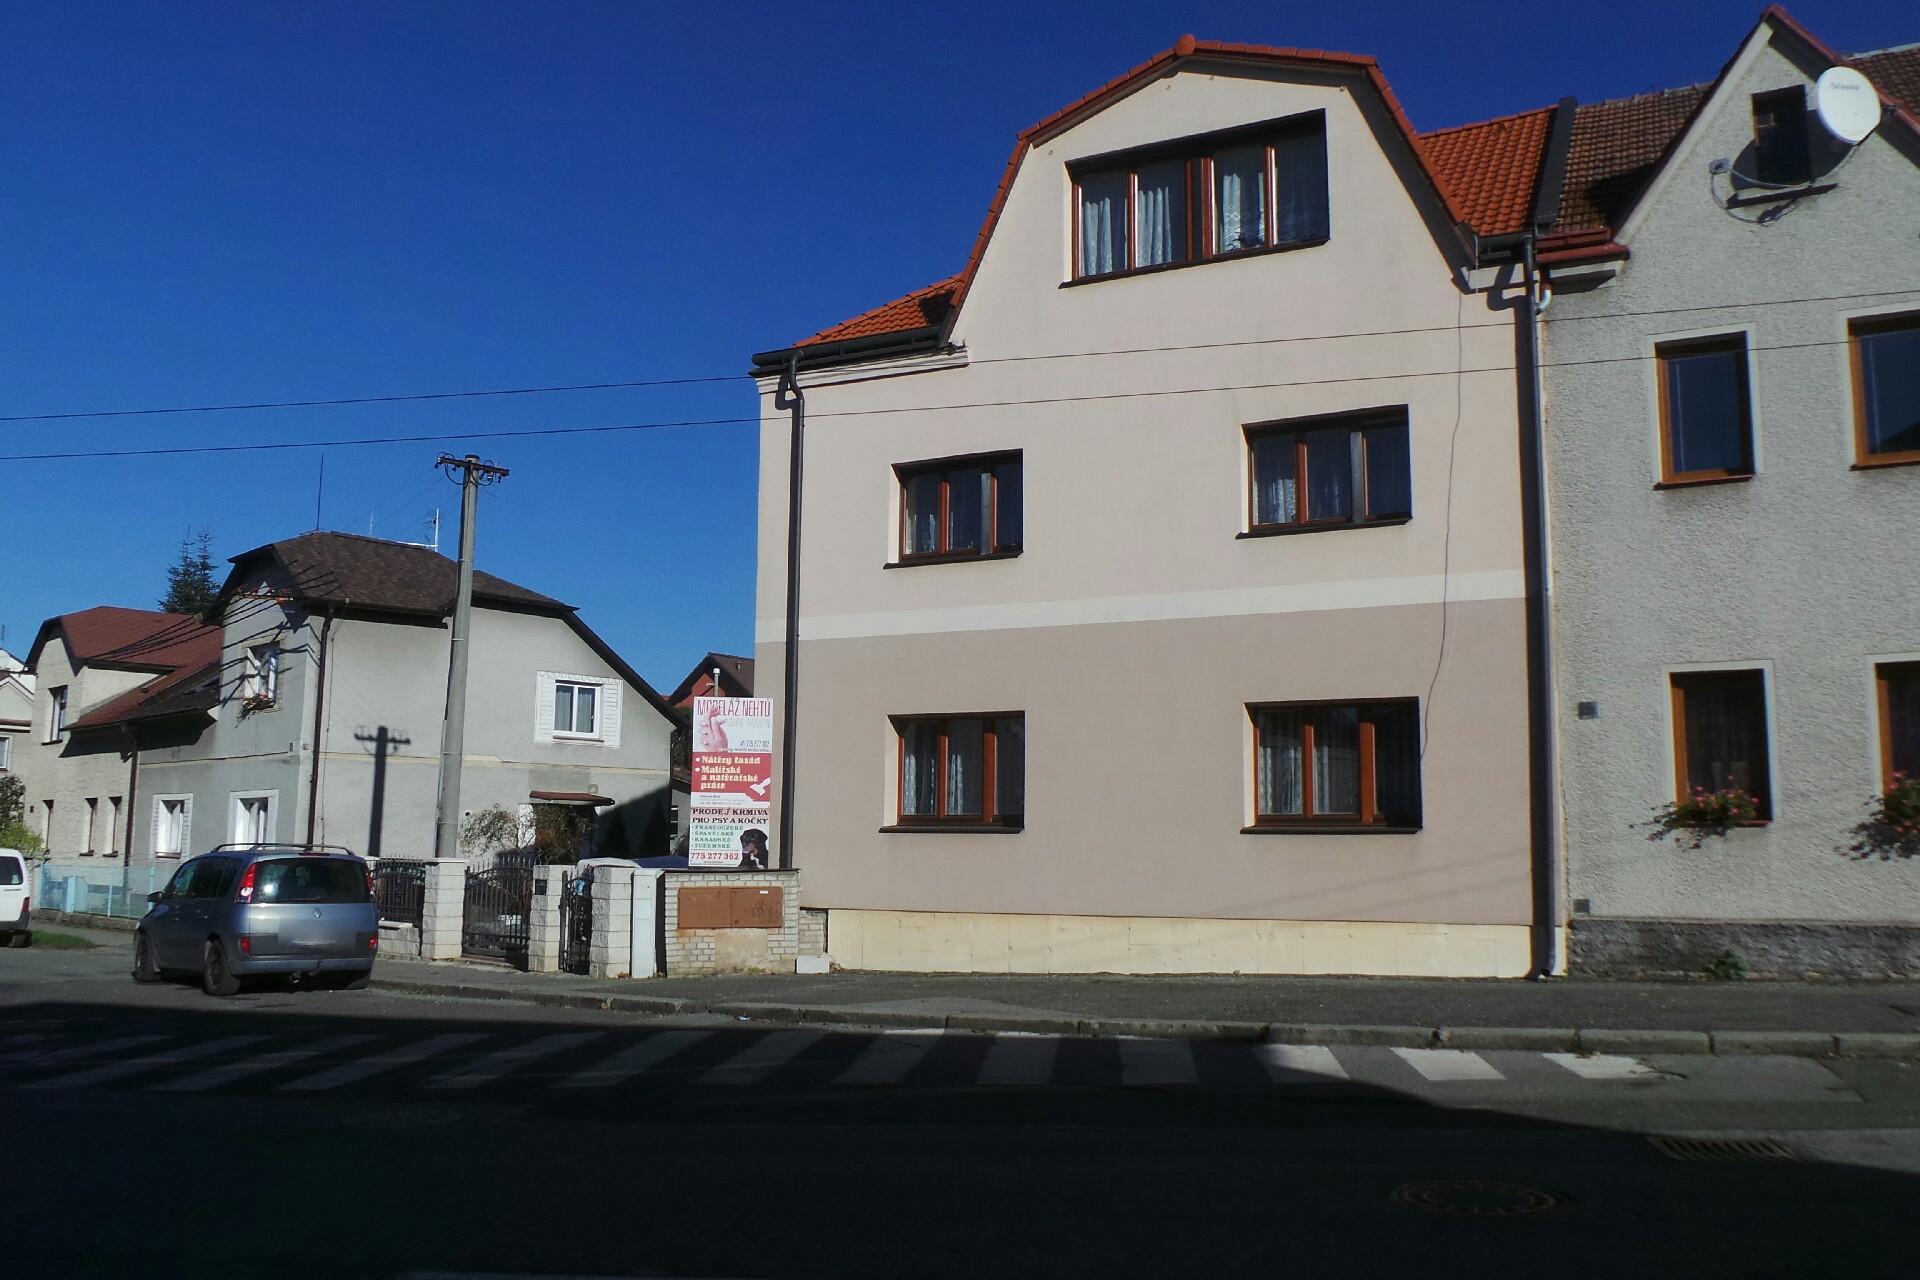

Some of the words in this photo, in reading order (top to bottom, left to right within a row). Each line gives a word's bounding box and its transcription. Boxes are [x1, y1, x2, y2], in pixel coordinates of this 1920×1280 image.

[701, 755, 732, 765] Nátěry
[734, 756, 761, 764] fasád
[701, 765, 741, 774] Malířské
[700, 781, 726, 790] práce
[692, 806, 731, 816] PRODEJ
[732, 808, 768, 816] KRMIVA
[737, 816, 769, 825] KOČKY
[690, 852, 706, 860] 775
[707, 852, 722, 860] 277
[723, 852, 739, 860] 362
